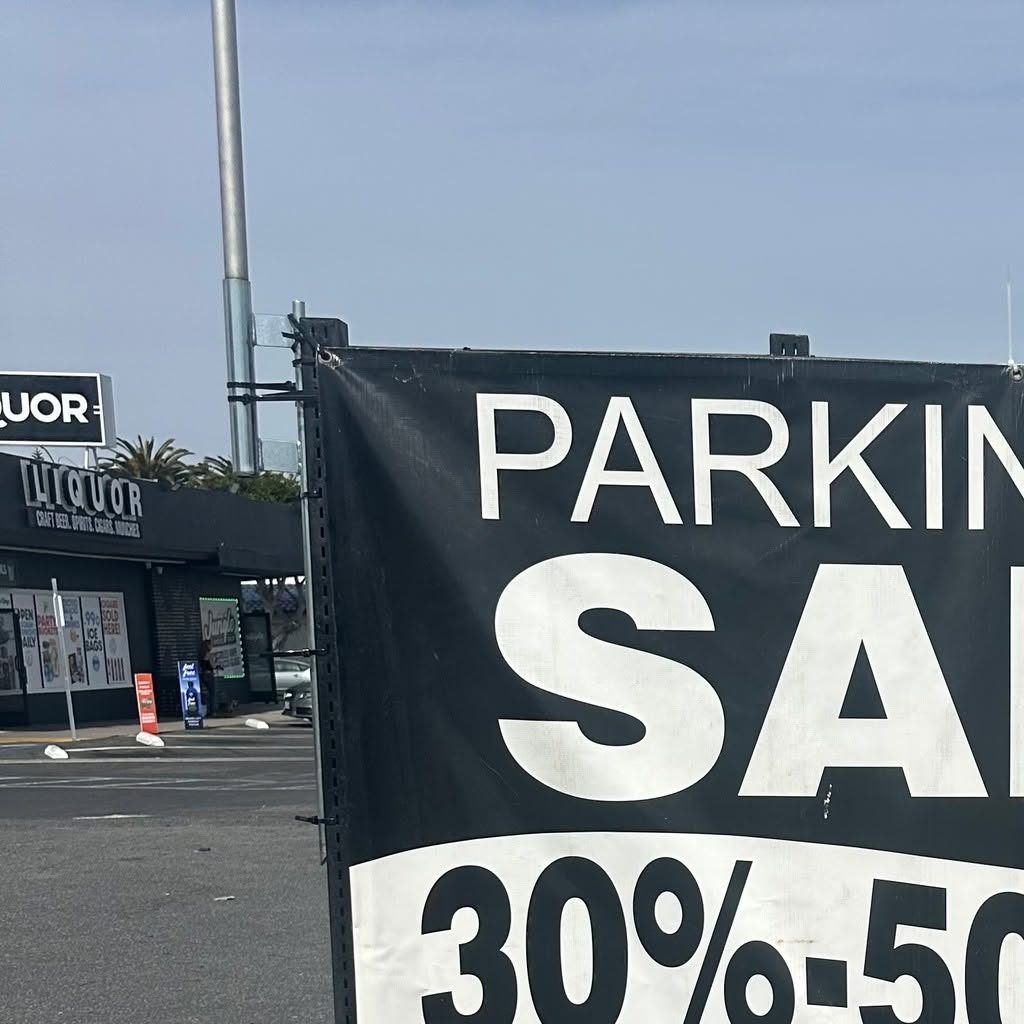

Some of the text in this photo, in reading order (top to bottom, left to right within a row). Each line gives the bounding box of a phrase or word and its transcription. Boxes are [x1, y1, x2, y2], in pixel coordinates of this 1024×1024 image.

[22, 460, 143, 518] LIQUOR
[36, 510, 55, 528] CRAFT
[102, 608, 119, 622] SOLD
[86, 627, 98, 640] ICE
[85, 639, 103, 652] BAGS
